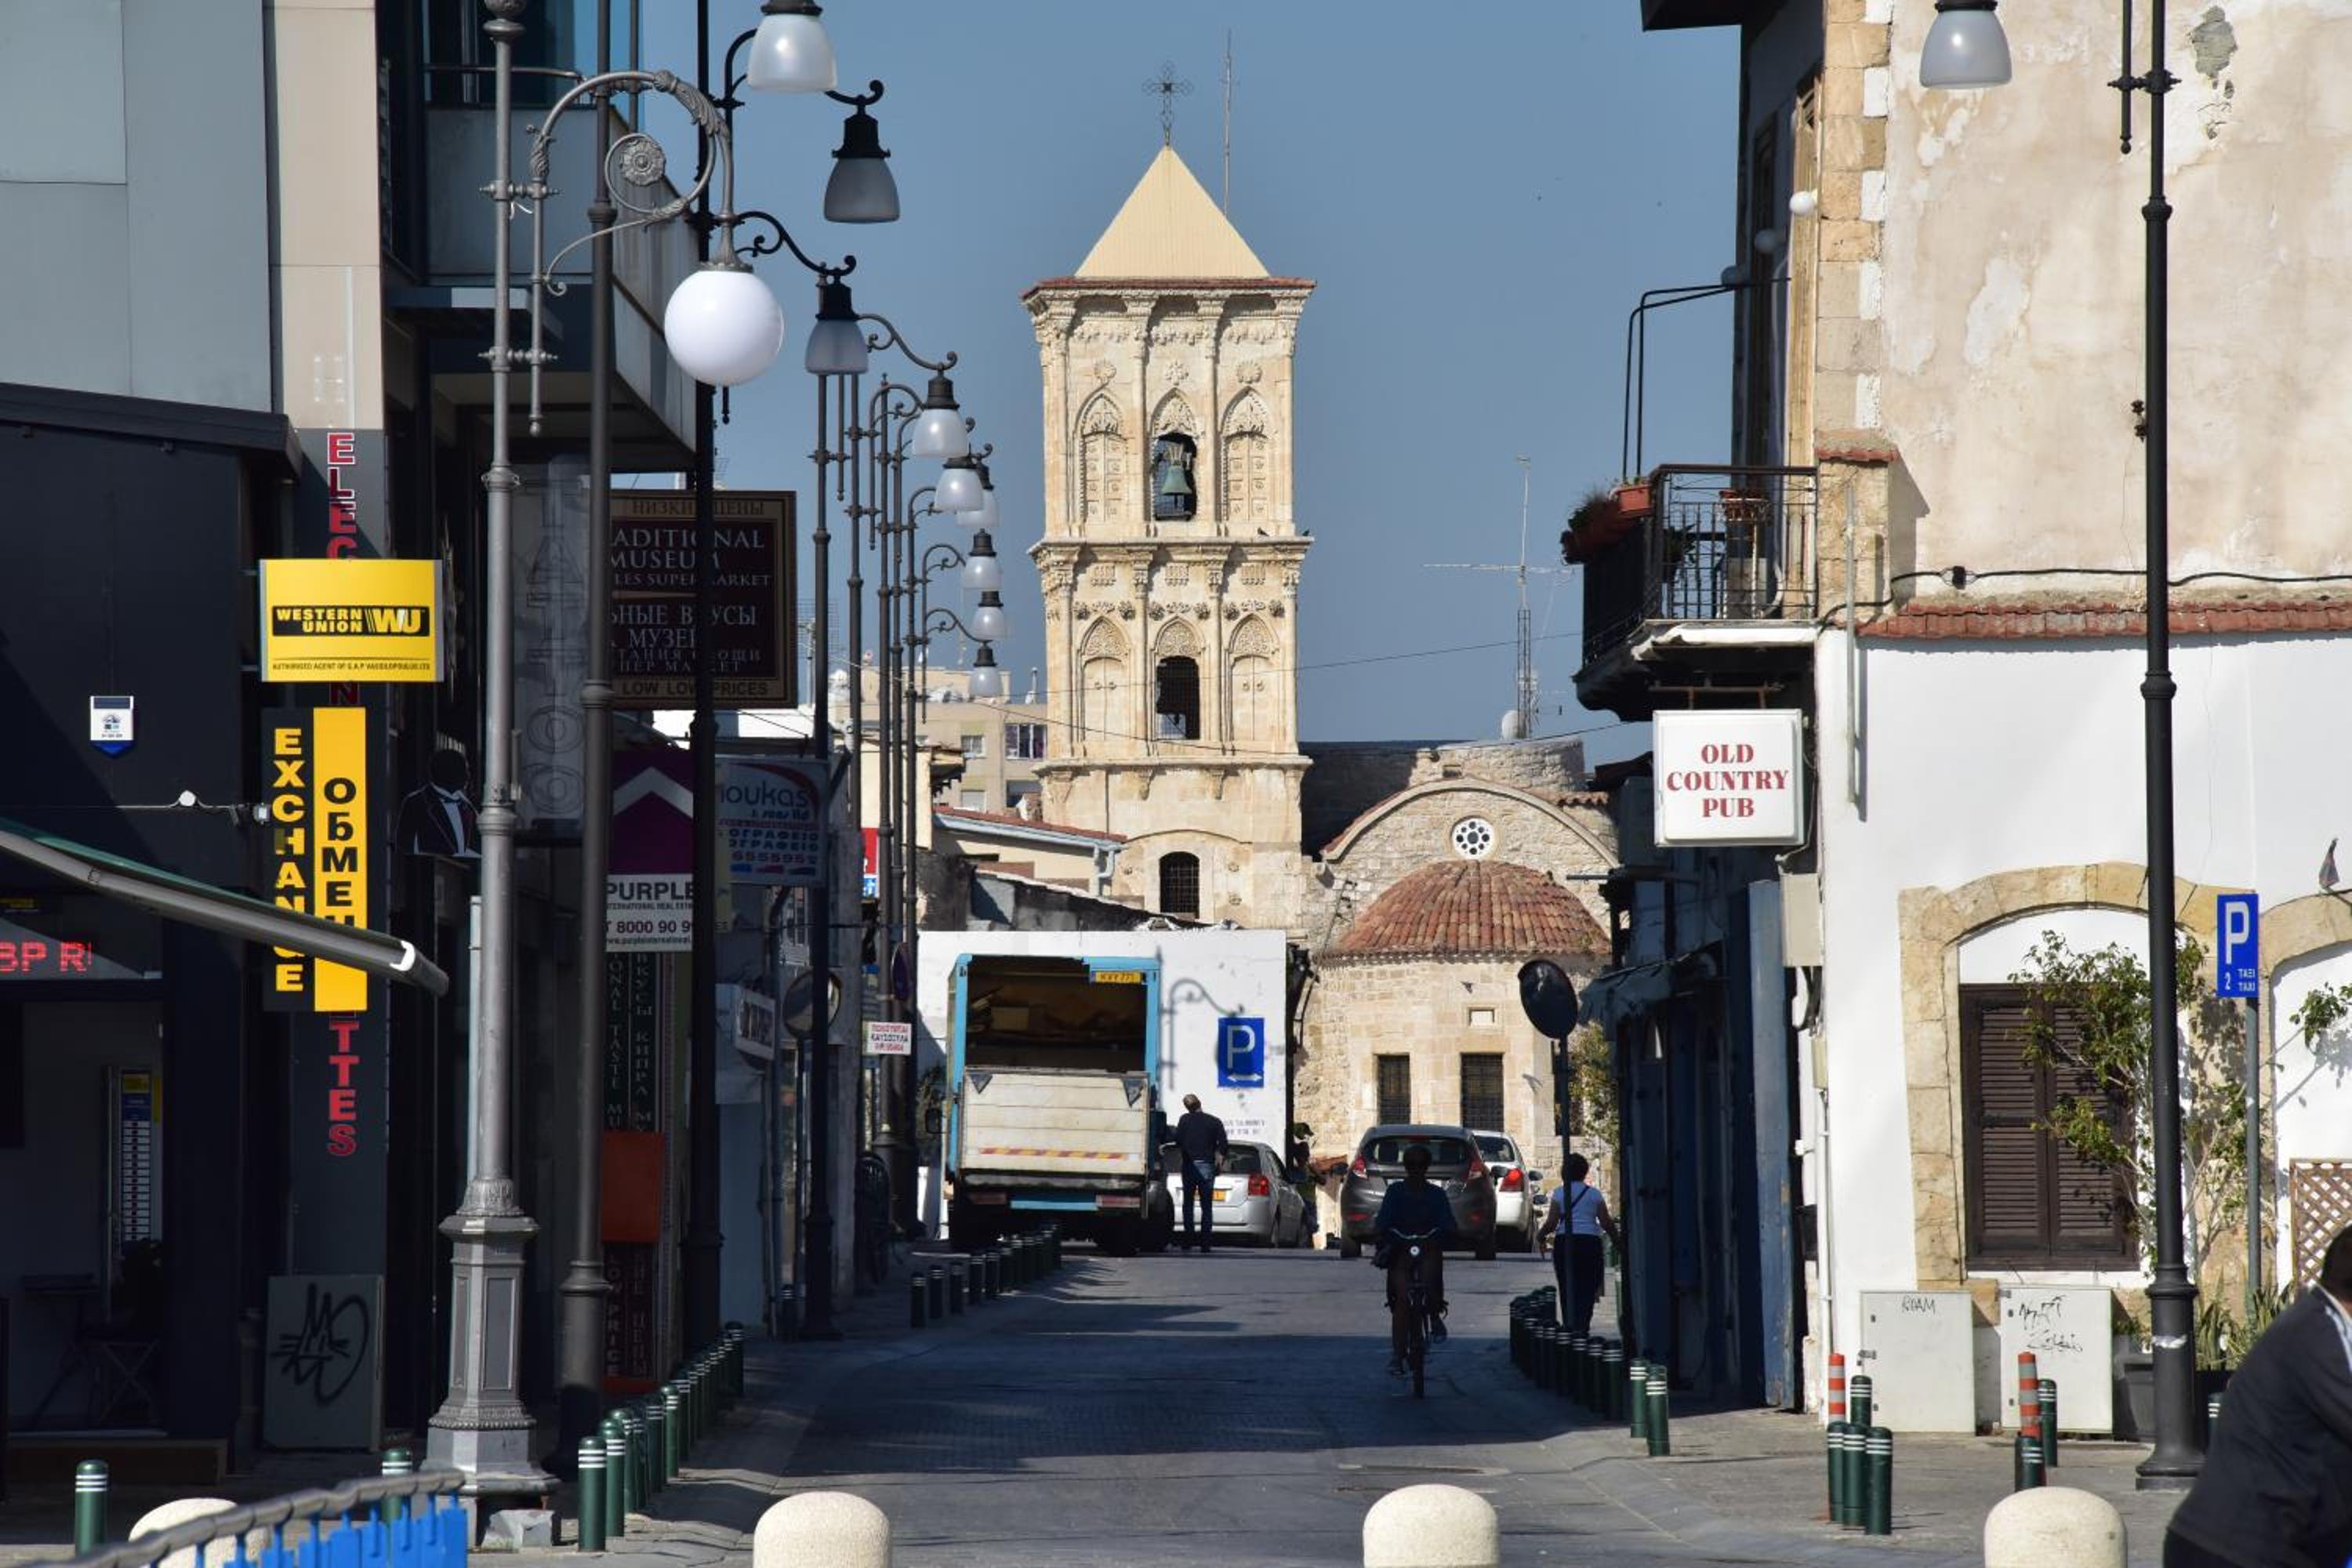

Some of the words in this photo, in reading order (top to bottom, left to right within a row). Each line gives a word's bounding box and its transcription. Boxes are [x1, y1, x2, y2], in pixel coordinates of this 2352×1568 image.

[276, 608, 362, 620] WESTERN
[681, 604, 757, 626] ВУСЫ
[302, 621, 362, 633] UNION
[622, 681, 658, 695] LOW
[1700, 744, 1754, 764] OLD
[1666, 770, 1789, 791] COUNTRY
[1702, 798, 1755, 818] PUB
[617, 920, 653, 933] 8000
[659, 920, 676, 933] 90
[2226, 902, 2249, 964] P
[2225, 972, 2231, 991] 2
[1226, 1025, 1255, 1069] P
